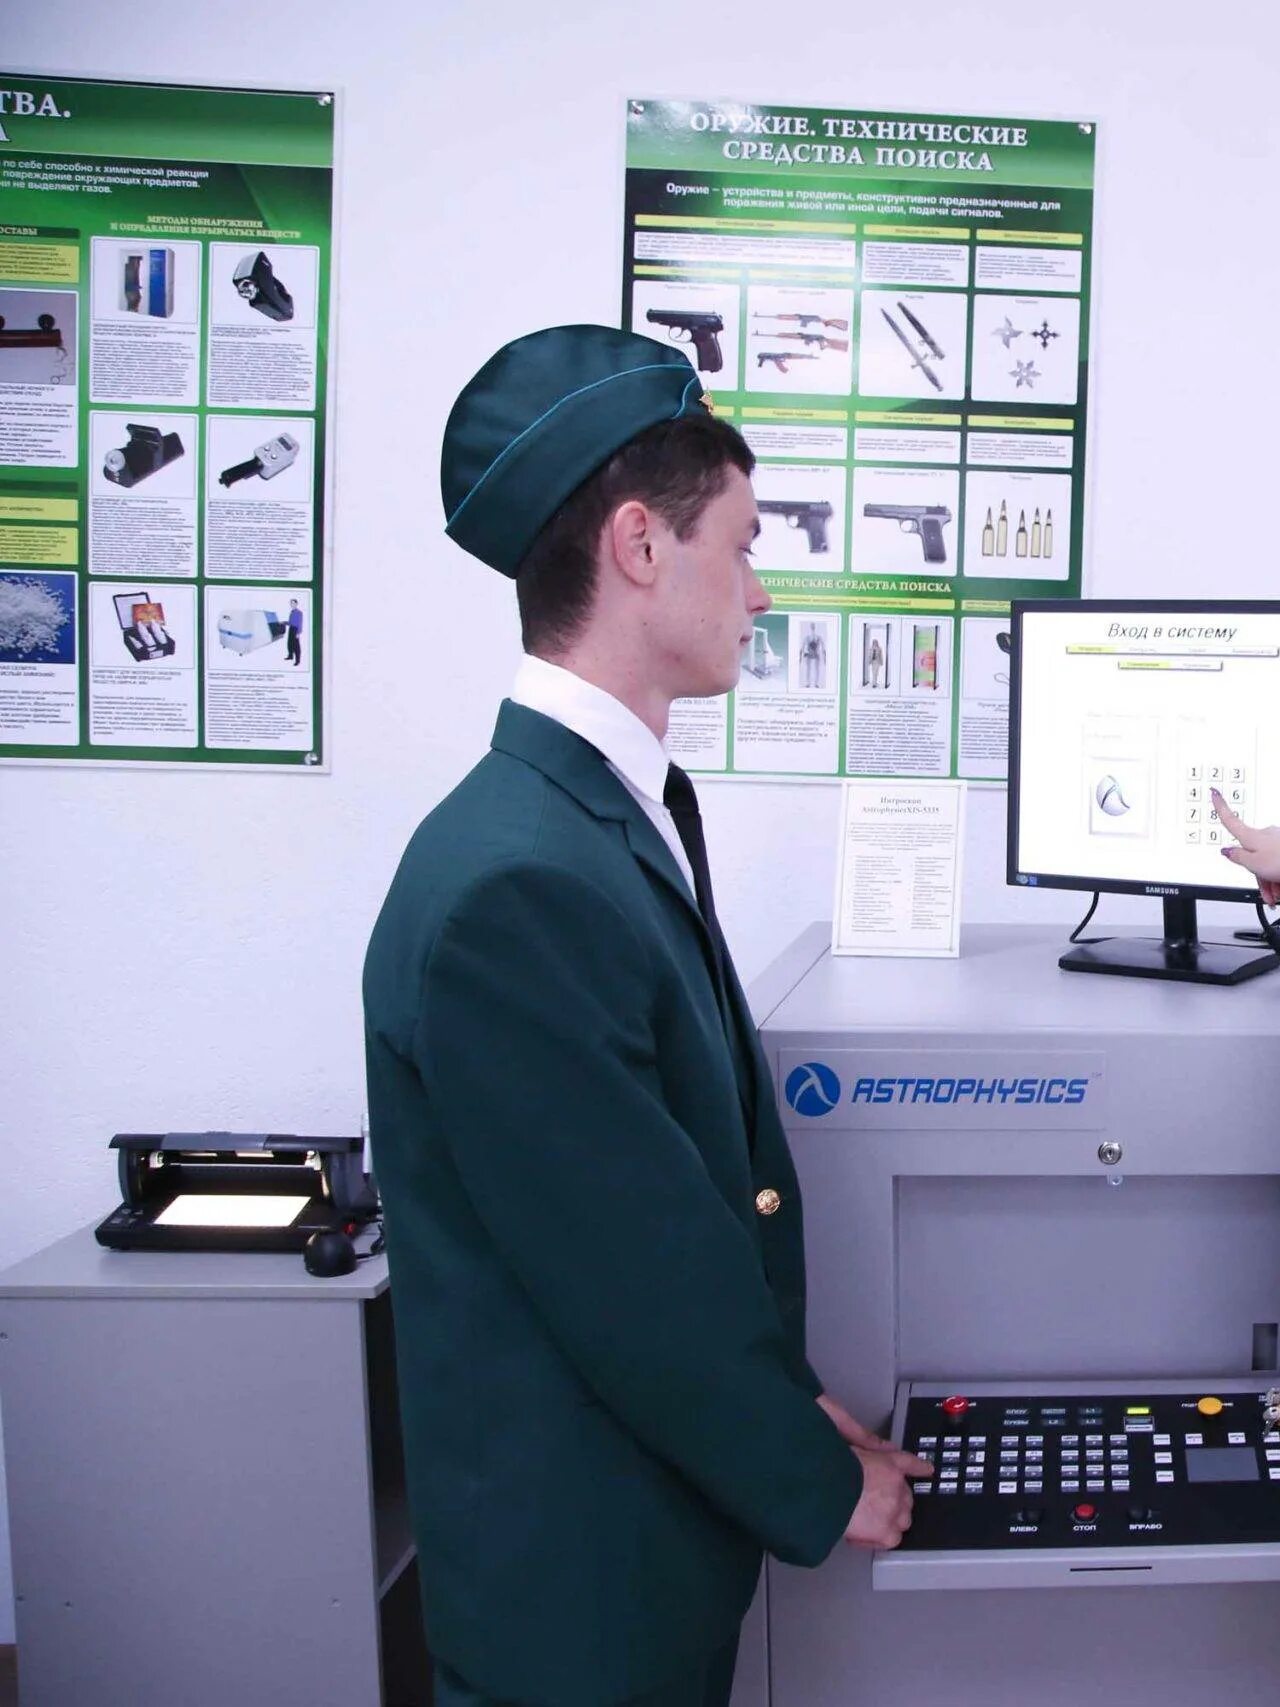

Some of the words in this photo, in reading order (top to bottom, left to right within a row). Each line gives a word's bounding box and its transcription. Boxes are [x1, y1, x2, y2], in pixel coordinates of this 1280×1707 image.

[690, 112, 816, 137] ОРУЖИЕ.
[823, 118, 1028, 147] ТЕХНИЧЕСКИЕ
[722, 140, 866, 166] СРЕДСТВА
[875, 147, 995, 172] ПОИСКА
[3, 170, 72, 181] повреждение
[75, 175, 140, 186] окружающих
[143, 178, 200, 189] предметов.
[18, 160, 42, 170] себе
[45, 162, 93, 173] способно
[103, 165, 164, 177] химической
[166, 169, 209, 180] реакции
[28, 182, 80, 192] выделяют
[666, 183, 709, 196] Оружие
[722, 187, 783, 198] устройства
[857, 193, 937, 205] конструктивно
[939, 197, 1038, 210] предназначенные
[1040, 202, 1060, 211] для
[723, 198, 785, 209] поражения
[788, 200, 823, 210] живой
[826, 203, 845, 211] или
[848, 204, 874, 212] иной
[909, 206, 949, 216] подачи
[951, 208, 1004, 218] сигналов.
[760, 577, 833, 589] ХНИЧЕСКИЕ
[836, 579, 897, 591] СРЕДСТВА
[900, 582, 951, 593] ПОИСКА
[1108, 622, 1148, 640] Вход
[1153, 628, 1162, 638] в
[1167, 627, 1238, 642] систему
[1212, 768, 1219, 778] 2
[1233, 768, 1240, 779] 3
[1232, 789, 1240, 800] 6
[1145, 886, 1179, 896] SAMSUNG
[851, 1077, 1090, 1104] ASTROPHYSICS
